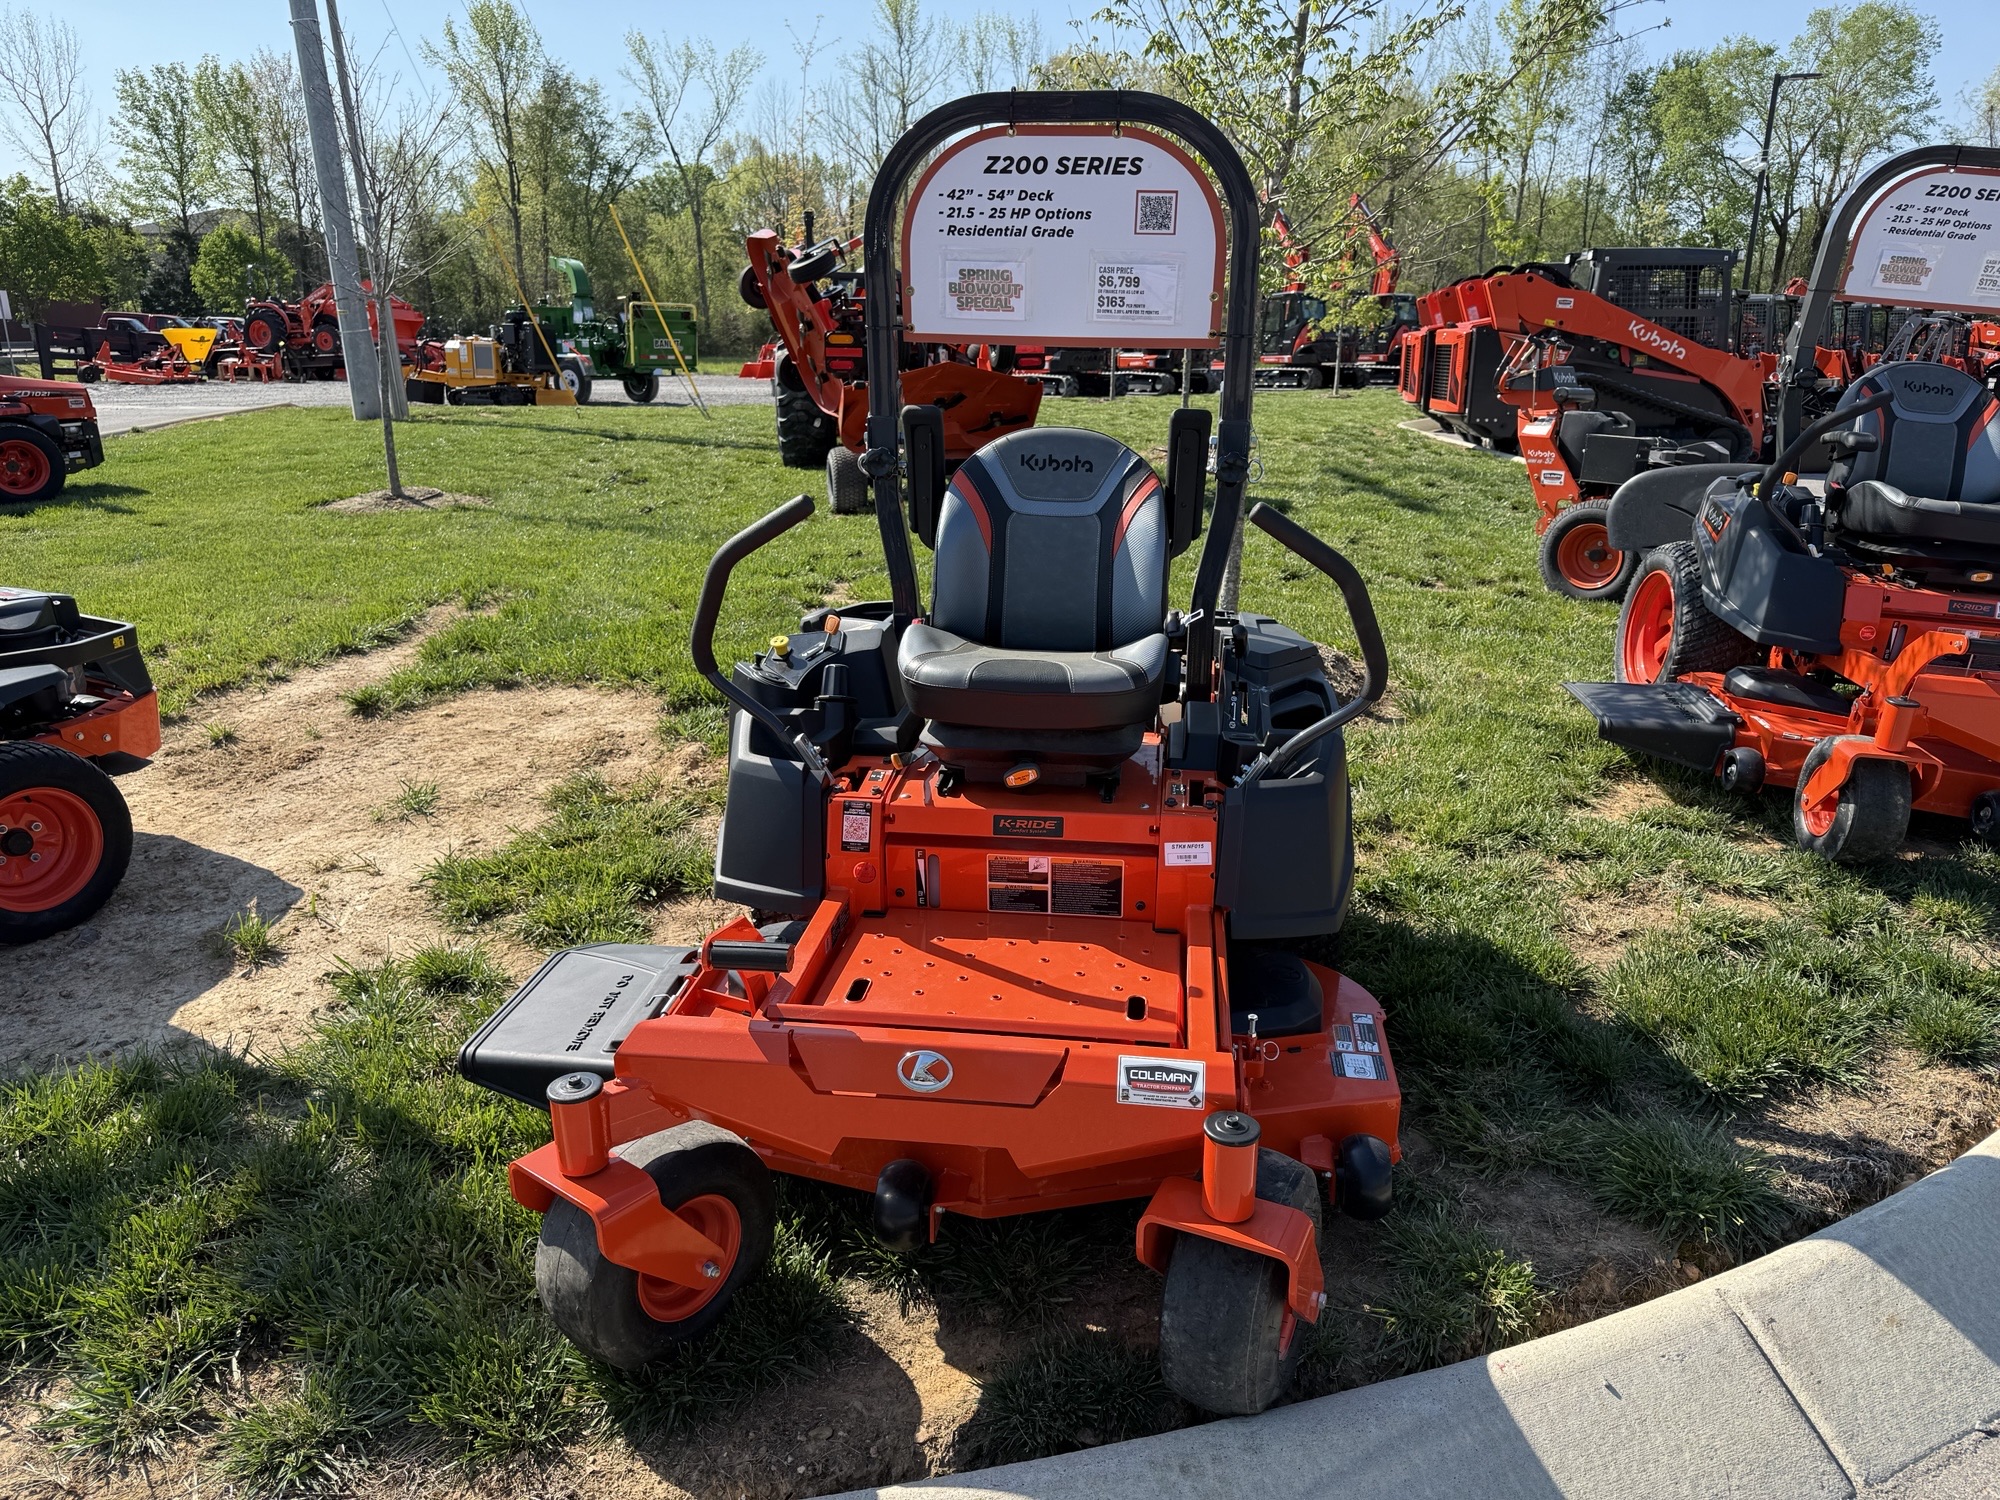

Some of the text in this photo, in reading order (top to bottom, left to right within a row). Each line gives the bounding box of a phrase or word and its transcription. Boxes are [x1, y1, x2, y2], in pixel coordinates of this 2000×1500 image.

[983, 155, 1144, 175] Z200 SERIES
[1017, 190, 1054, 201] Deck
[1925, 184, 1972, 199] Z200
[946, 207, 975, 219] 21.5
[988, 208, 1006, 219] 25
[1010, 208, 1030, 219] HP
[1035, 208, 1092, 222] Options
[1944, 208, 1970, 216] Deck
[1891, 215, 1913, 224] 21.5
[1936, 218, 1951, 227] HP
[1953, 220, 1992, 231] Options
[947, 224, 1027, 237] Residential
[1031, 226, 1074, 238] Grade
[1888, 226, 1946, 238] Residential
[1947, 231, 1977, 241] Grade
[1890, 256, 1927, 266] SPRING
[958, 268, 1012, 282] SPRING
[1880, 264, 1932, 276] BLOWOUT
[1098, 274, 1140, 288] $6,799
[1882, 274, 1922, 285] SPECIAL
[1978, 278, 1998, 287] $179
[948, 282, 1022, 298] BLOWOUT
[956, 296, 1014, 310] SPECIAL
[1098, 295, 1125, 308] $163
[1628, 320, 1687, 360] Kubota
[1554, 372, 1576, 384] Kubota
[1904, 380, 1954, 396] Kubota
[1021, 454, 1093, 473] Kubota
[1953, 602, 1991, 612] K-RIDE
[999, 819, 1057, 829] K-RIDE
[566, 974, 634, 1051] DO NOT REMOVE
[1130, 1069, 1192, 1083] COLEMAN
